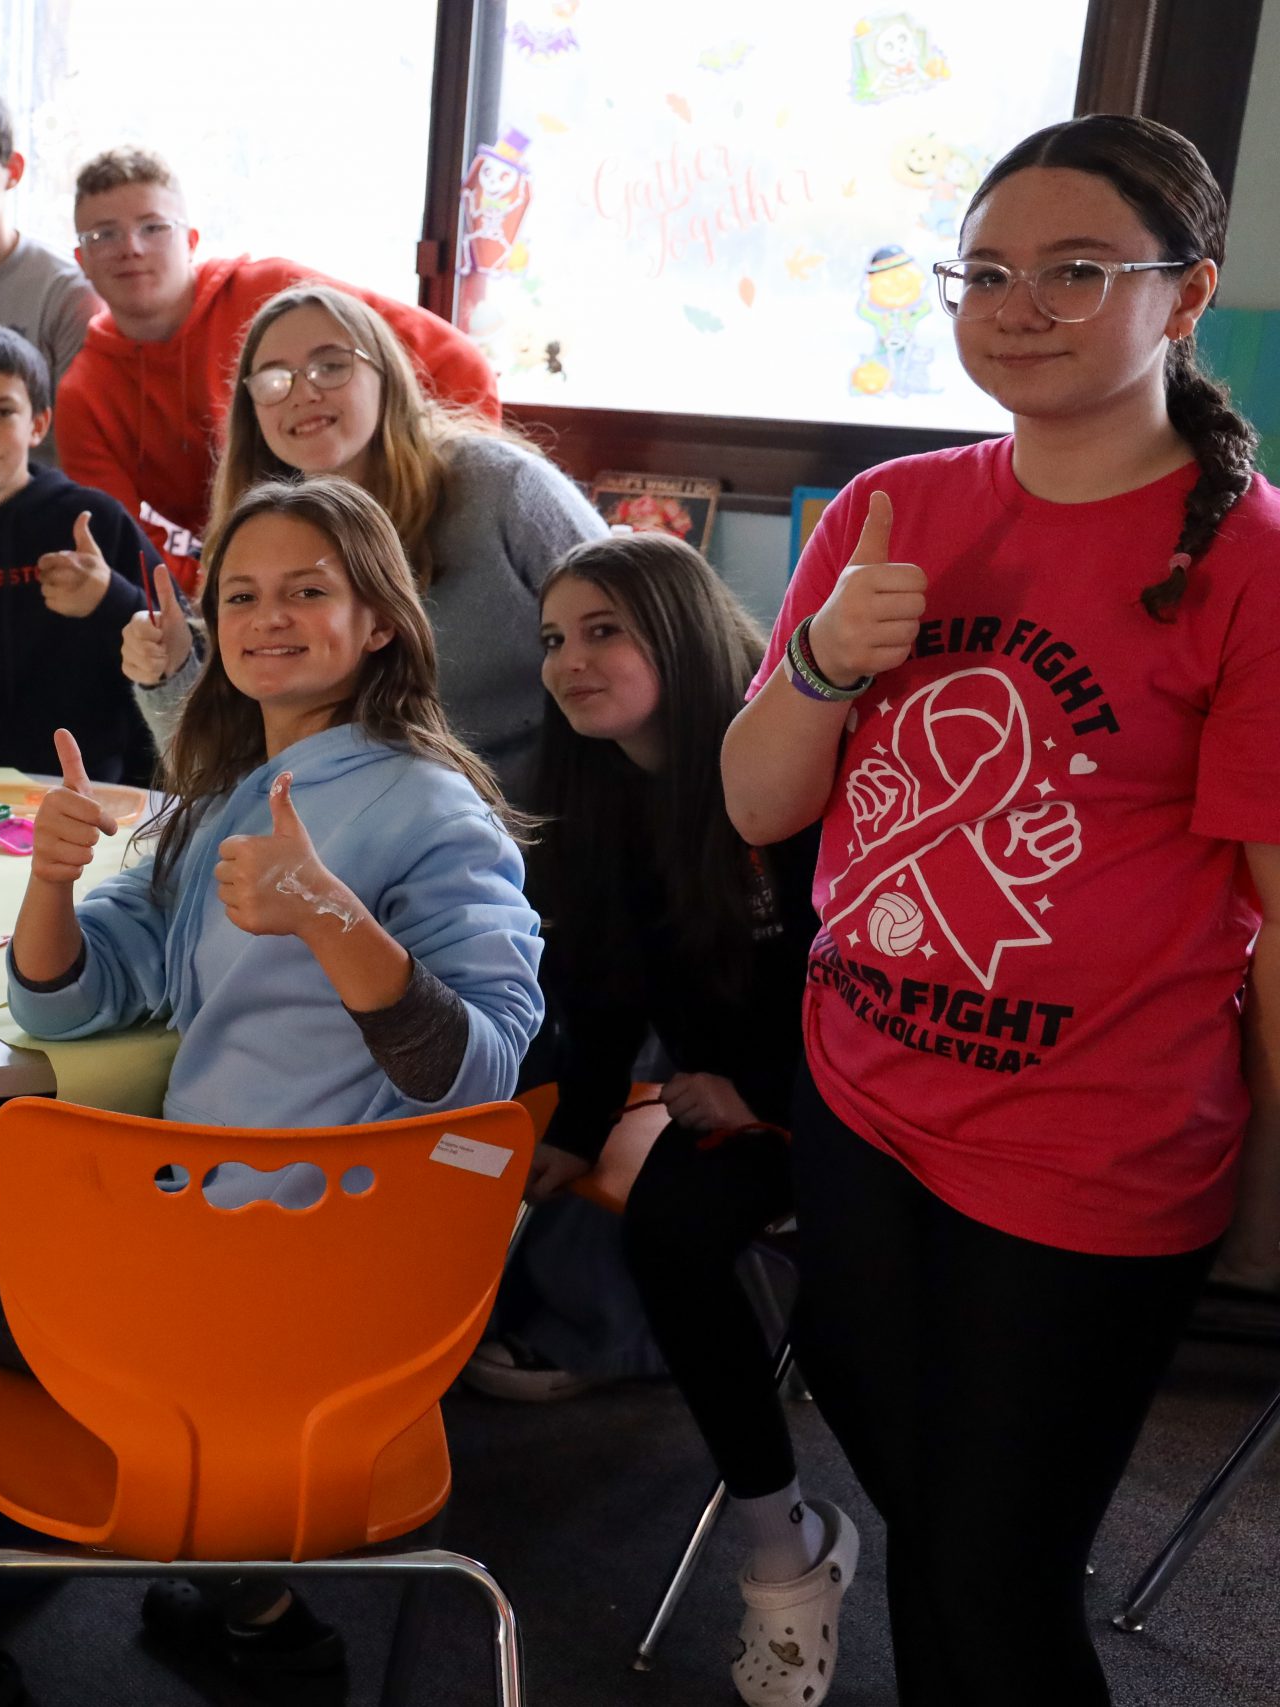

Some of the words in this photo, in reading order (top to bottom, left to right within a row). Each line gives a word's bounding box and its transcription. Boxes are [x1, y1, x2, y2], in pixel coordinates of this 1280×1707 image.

[577, 142, 734, 238] Gather
[638, 166, 815, 279] Together
[790, 642, 832, 698] BREATHE
[910, 616, 1002, 660] EIR
[1002, 619, 1120, 736] FIGHT
[900, 978, 1074, 1047] FIGHT
